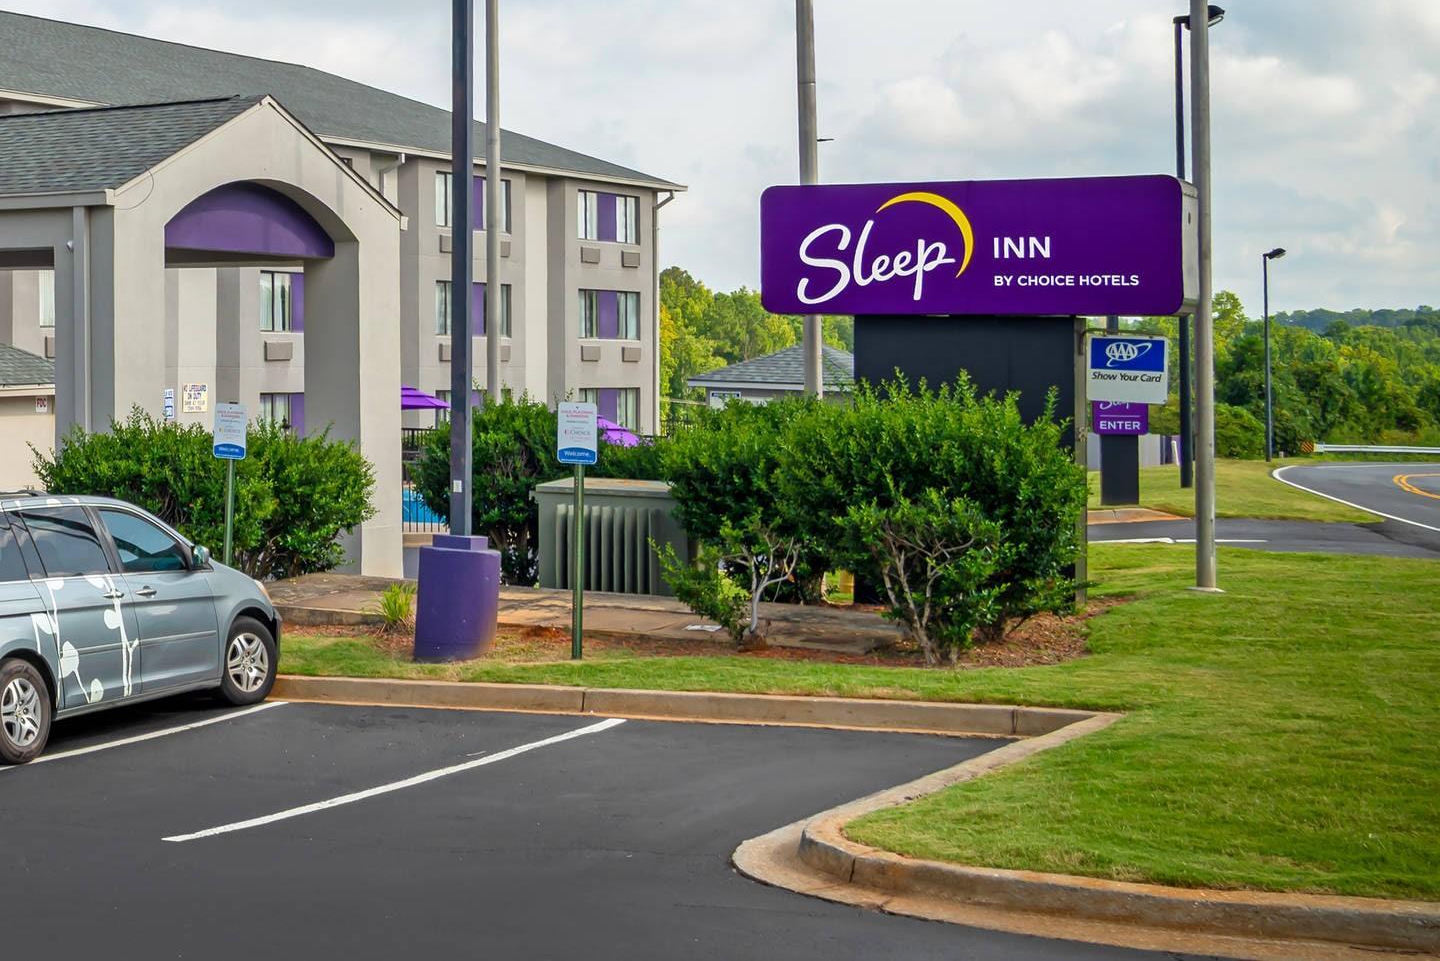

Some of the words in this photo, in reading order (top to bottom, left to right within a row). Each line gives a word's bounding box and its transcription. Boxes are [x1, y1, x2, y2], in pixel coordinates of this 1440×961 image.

[796, 219, 956, 305] Sleep
[993, 236, 1051, 259] INN
[994, 275, 1012, 286] BY
[1017, 275, 1075, 286] CHOICE
[1079, 274, 1140, 286] HOTELS
[1109, 343, 1134, 360] AAA
[1092, 371, 1117, 380] Show
[1119, 373, 1138, 382] Your
[1140, 374, 1162, 383] Card
[1099, 420, 1141, 430] ENTER
